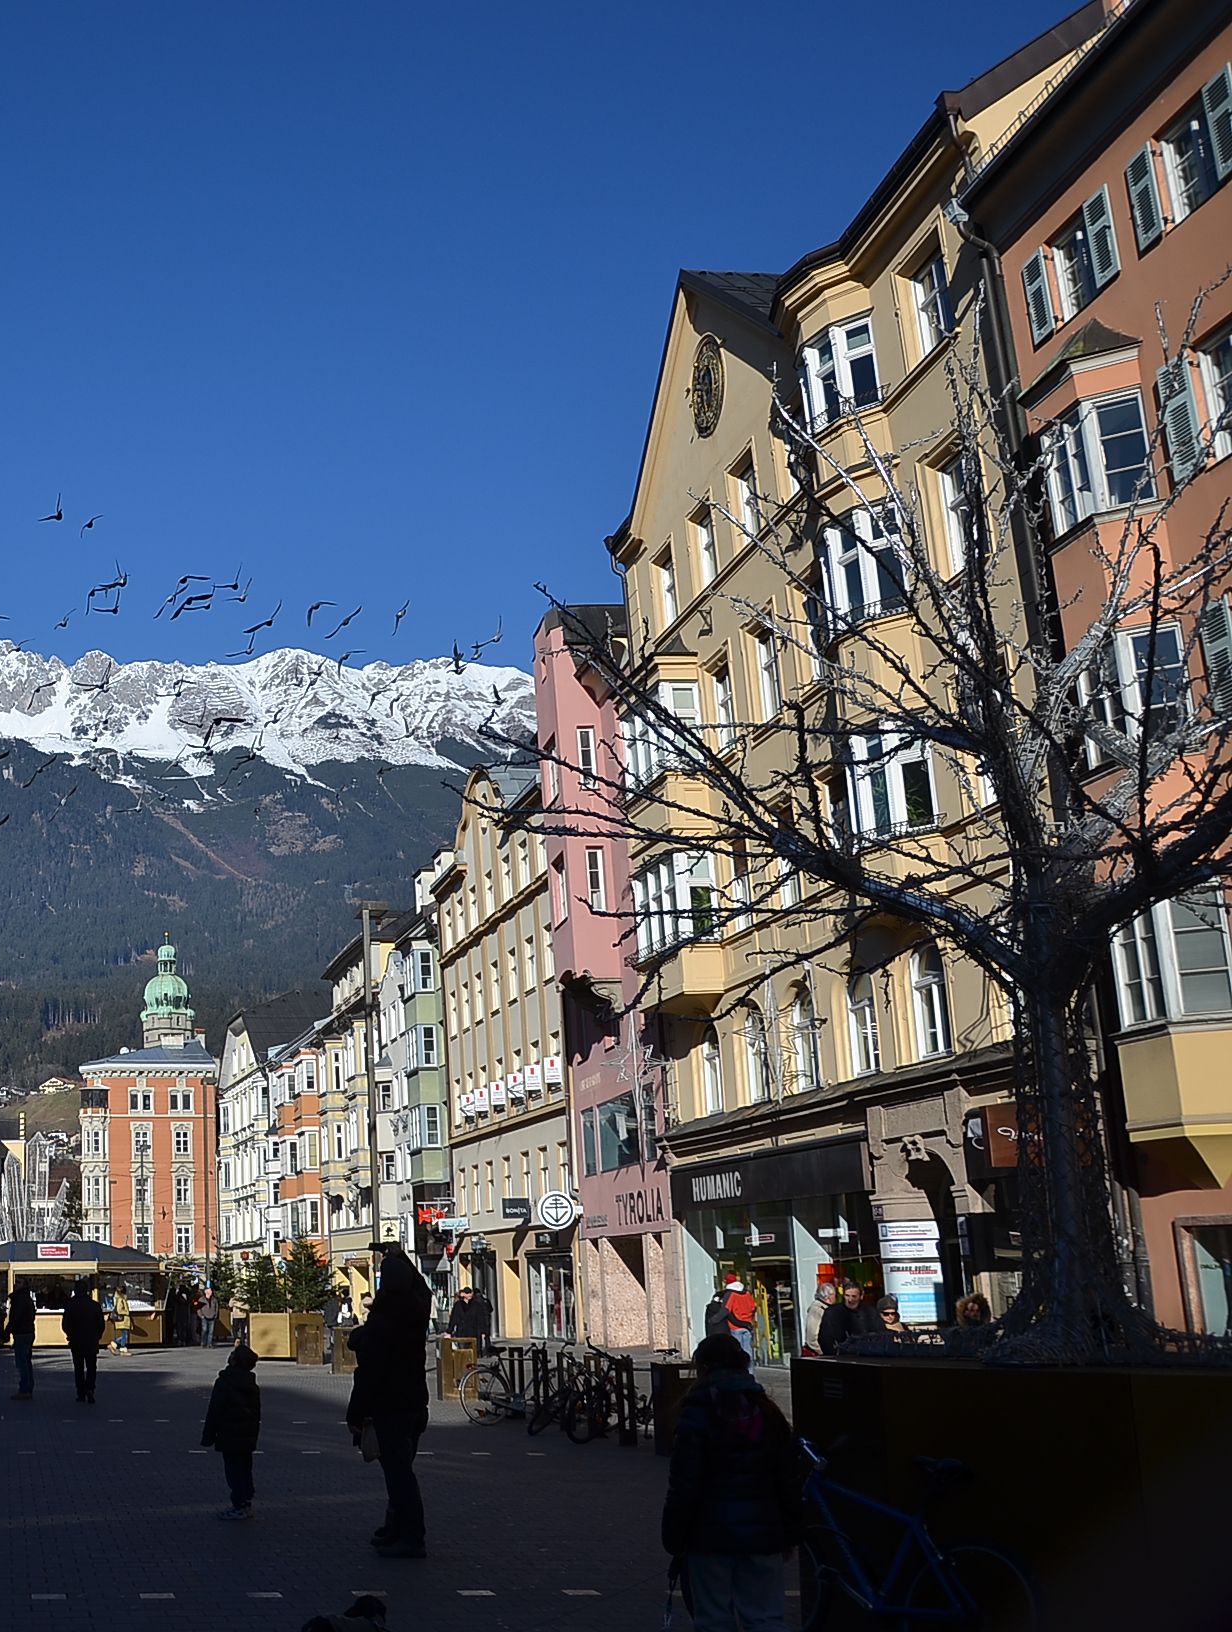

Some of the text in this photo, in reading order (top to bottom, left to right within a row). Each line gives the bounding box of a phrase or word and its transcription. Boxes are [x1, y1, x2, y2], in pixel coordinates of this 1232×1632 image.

[691, 1171, 742, 1202] HUMANIC
[505, 1206, 528, 1215] BONITA
[615, 1187, 665, 1226] TYROLIA
